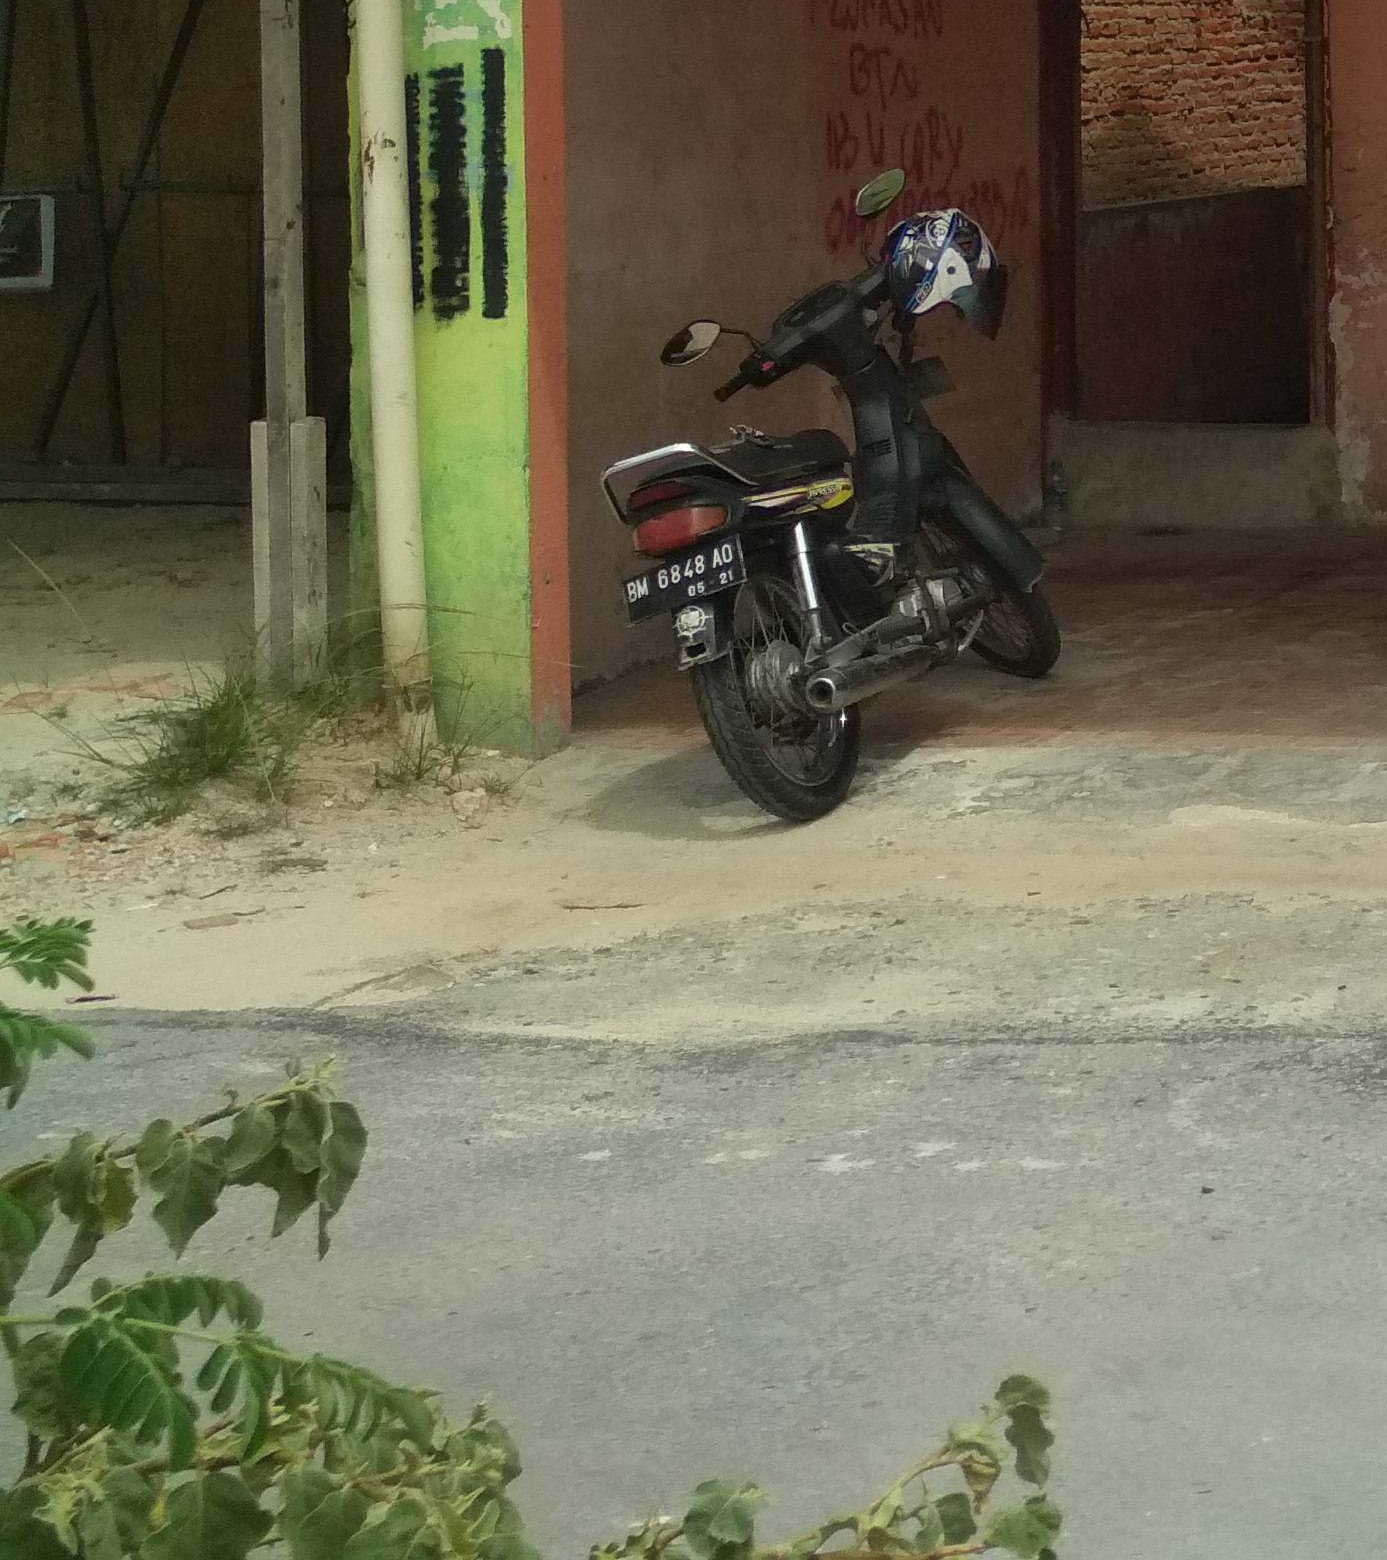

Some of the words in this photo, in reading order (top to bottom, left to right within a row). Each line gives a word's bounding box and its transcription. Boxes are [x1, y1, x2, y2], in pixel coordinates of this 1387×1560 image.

[626, 576, 649, 603] BM
[657, 554, 705, 589] 6848
[712, 543, 733, 569] AO
[687, 581, 705, 597] 05
[719, 569, 734, 585] 21
